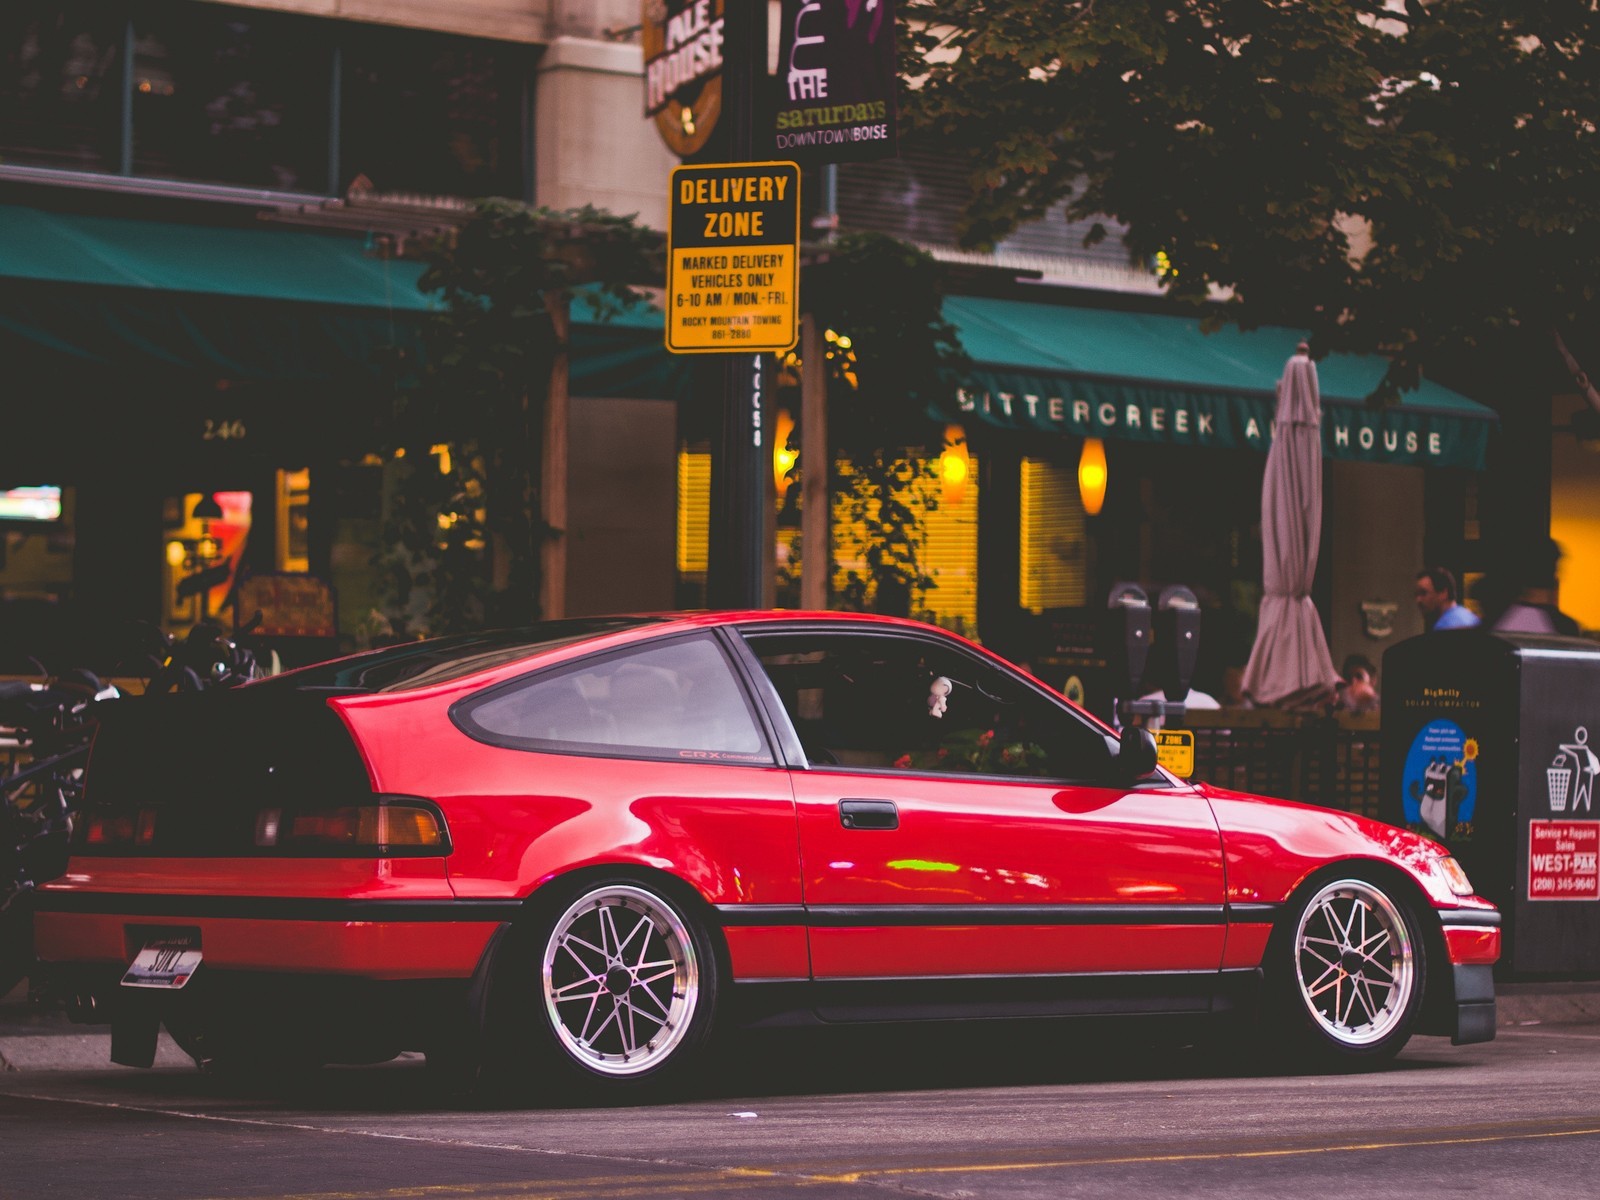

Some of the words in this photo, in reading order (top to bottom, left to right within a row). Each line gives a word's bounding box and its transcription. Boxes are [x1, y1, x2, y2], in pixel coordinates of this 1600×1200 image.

[666, 0, 709, 50] ALE
[647, 18, 724, 110] HOUSE
[788, 68, 828, 100] THE
[681, 176, 788, 204] DELIVERY
[704, 211, 764, 238] ZONE
[682, 255, 728, 270] MARKED
[732, 254, 784, 269] DELIVERY
[691, 274, 742, 288] VEHICLES
[749, 273, 774, 287] ONLY
[677, 292, 701, 307] 6-10
[705, 292, 722, 306] AM
[682, 316, 707, 327] ROCKY
[710, 316, 749, 327] MOUNTAIN
[752, 315, 782, 325] TOWING
[202, 419, 246, 440] 246
[1335, 425, 1441, 454] HOUSE
[1535, 826, 1562, 839] Service
